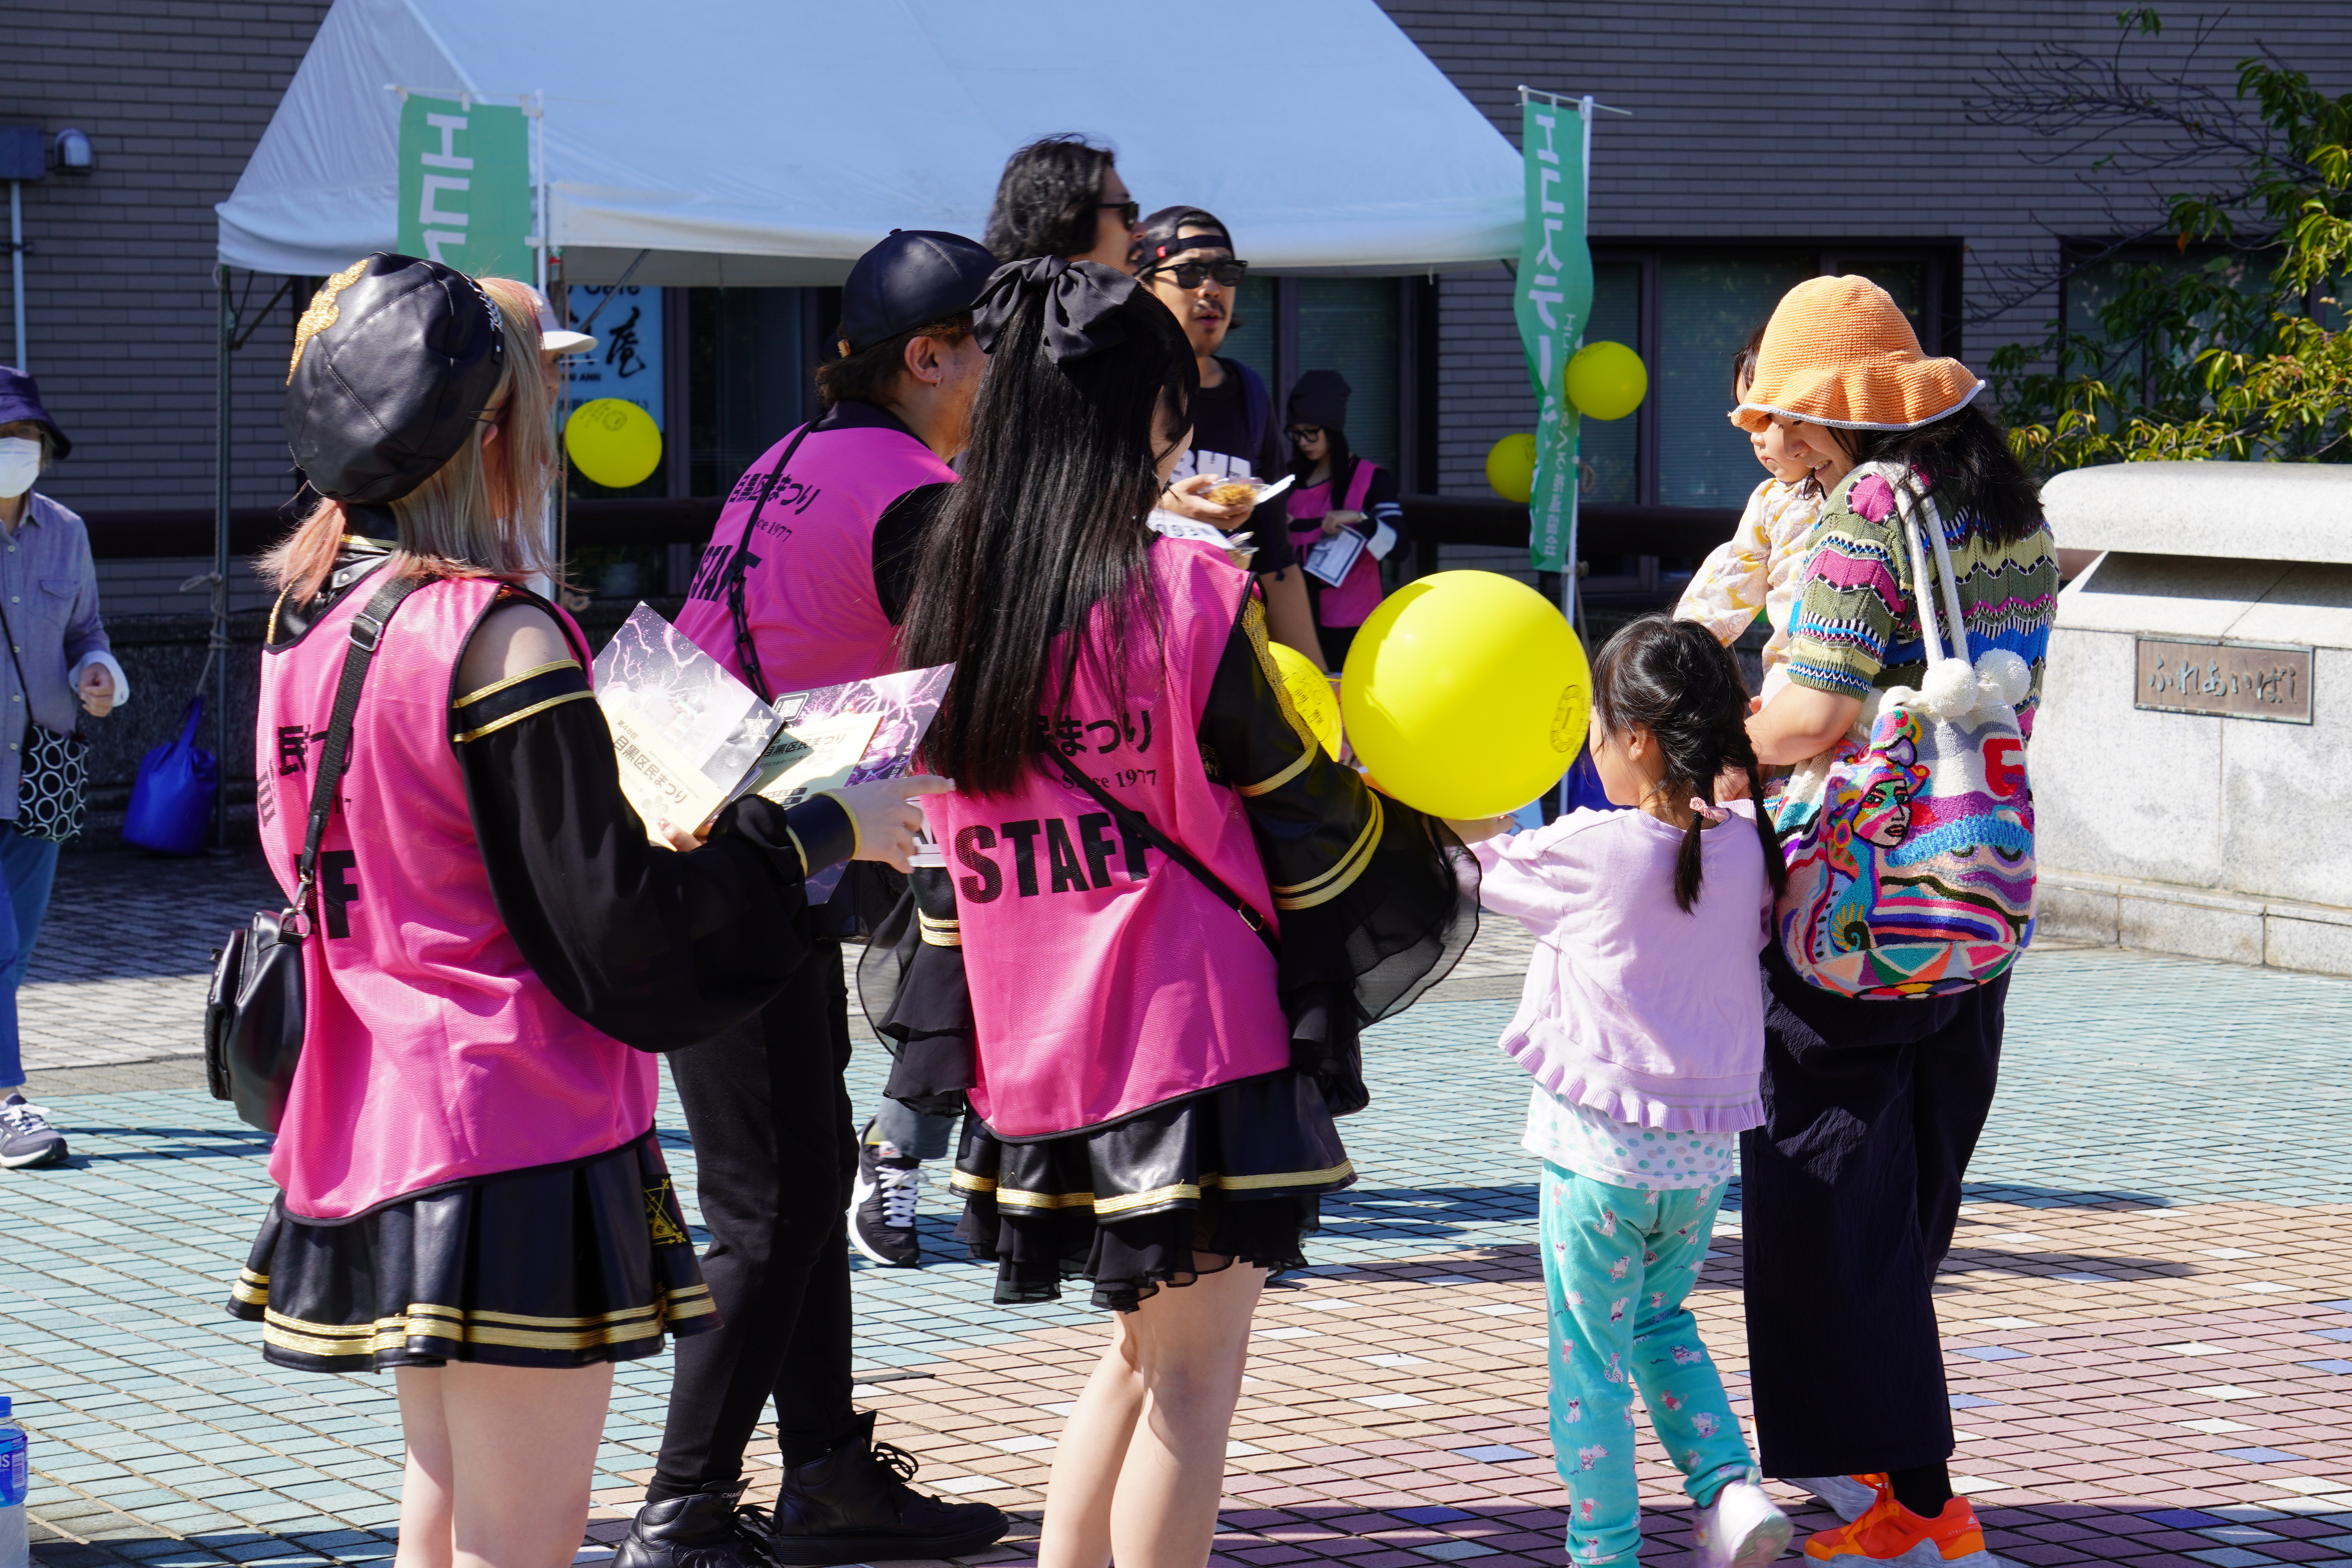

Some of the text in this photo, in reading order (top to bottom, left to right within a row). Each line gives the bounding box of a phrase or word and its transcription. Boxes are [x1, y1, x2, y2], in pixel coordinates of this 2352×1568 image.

[2149, 654, 2297, 704] ふれあいばし
[613, 735, 687, 804] 目黒区民まつり
[1114, 768, 1156, 788] 1977
